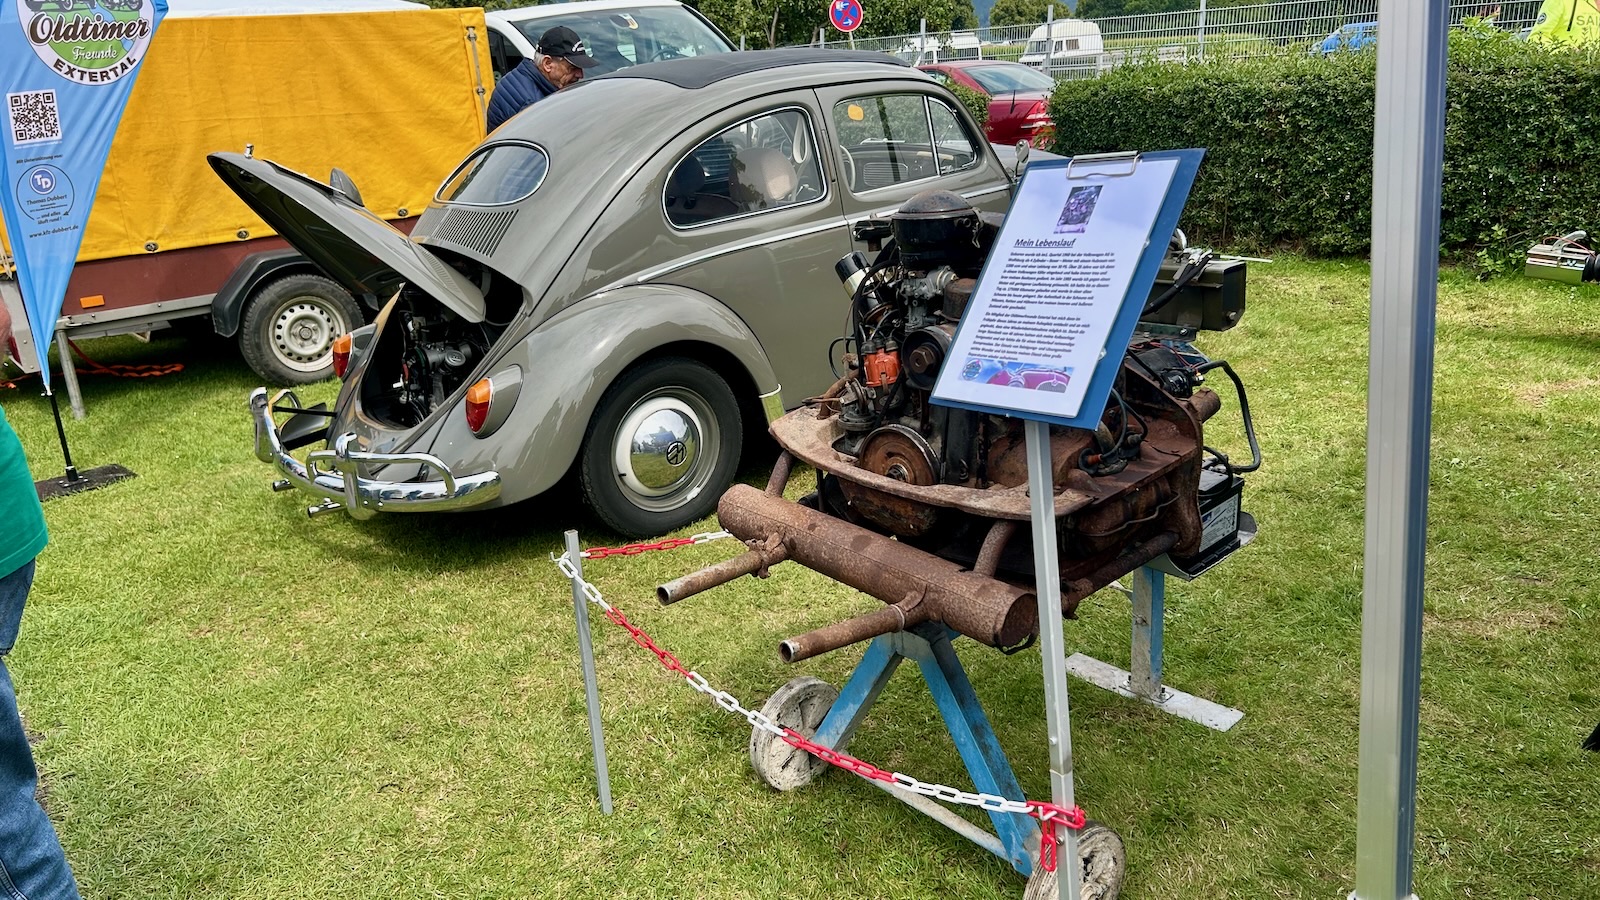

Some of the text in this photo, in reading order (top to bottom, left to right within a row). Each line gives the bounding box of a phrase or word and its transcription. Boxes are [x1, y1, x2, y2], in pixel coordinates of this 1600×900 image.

[29, 12, 150, 44] Oldtimer
[72, 45, 118, 61] Freunde
[53, 56, 137, 83] EXTERTAL
[34, 174, 52, 189] TD
[26, 198, 46, 206] Thomas
[1036, 238, 1077, 247] Lebenslauf
